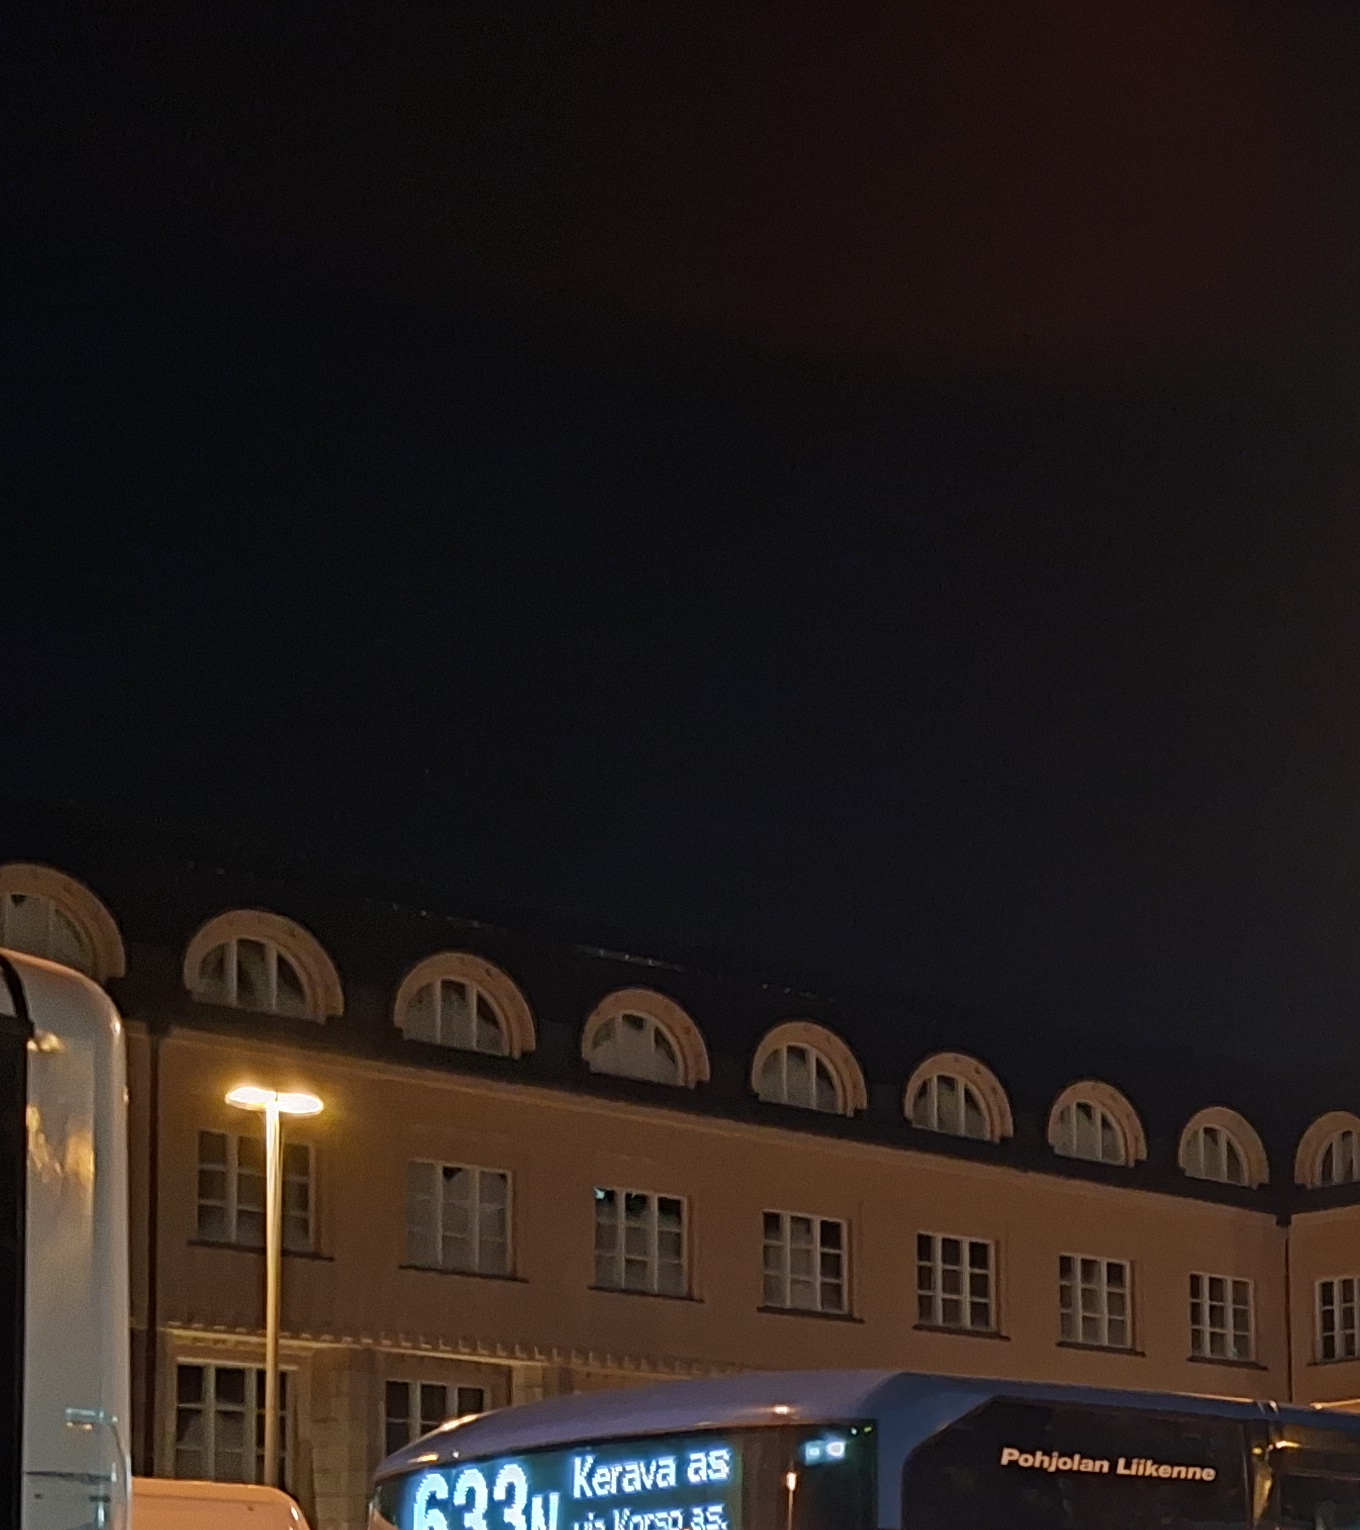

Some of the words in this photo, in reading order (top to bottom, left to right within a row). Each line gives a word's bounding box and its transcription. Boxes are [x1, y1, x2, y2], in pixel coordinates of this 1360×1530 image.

[573, 1454, 678, 1498] Kerava
[1000, 1447, 1110, 1473] Pohjolan
[1115, 1457, 1217, 1481] Liikenne
